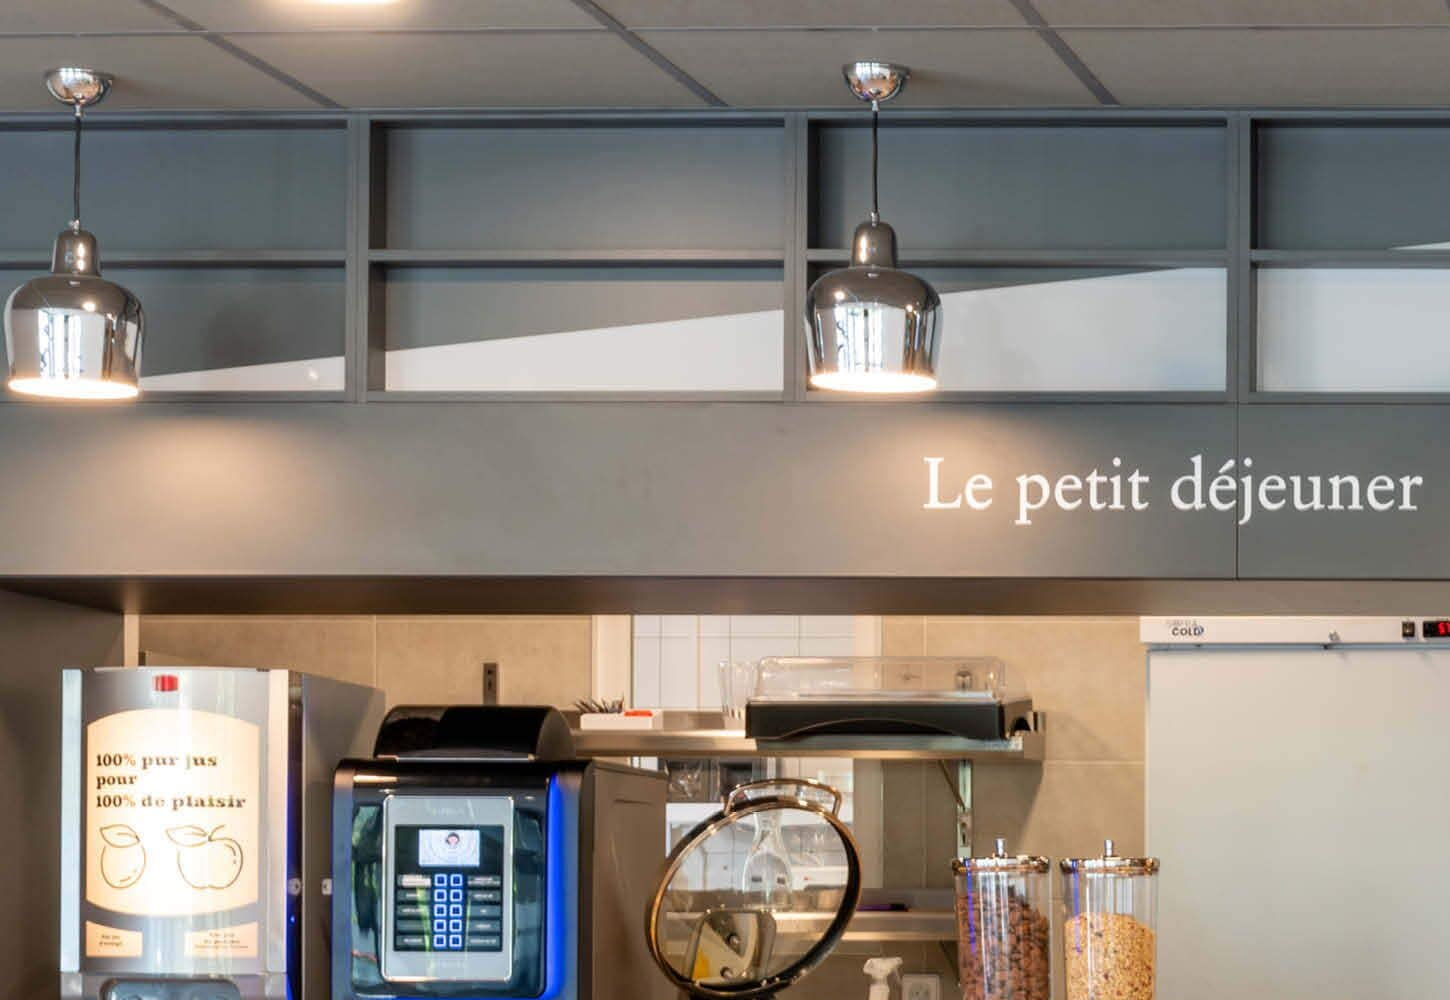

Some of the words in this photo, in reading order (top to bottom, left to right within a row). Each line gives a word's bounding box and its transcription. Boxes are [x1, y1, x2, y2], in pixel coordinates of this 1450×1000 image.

[922, 456, 994, 511] Le
[1014, 456, 1151, 525] petit
[1170, 454, 1424, 525] déjeuner
[96, 753, 137, 768] 100%
[141, 755, 179, 770] pur
[185, 754, 218, 770] jus
[96, 775, 138, 790] pour
[96, 794, 137, 809] 100%
[141, 795, 166, 809] de
[171, 794, 246, 811] plaisir
